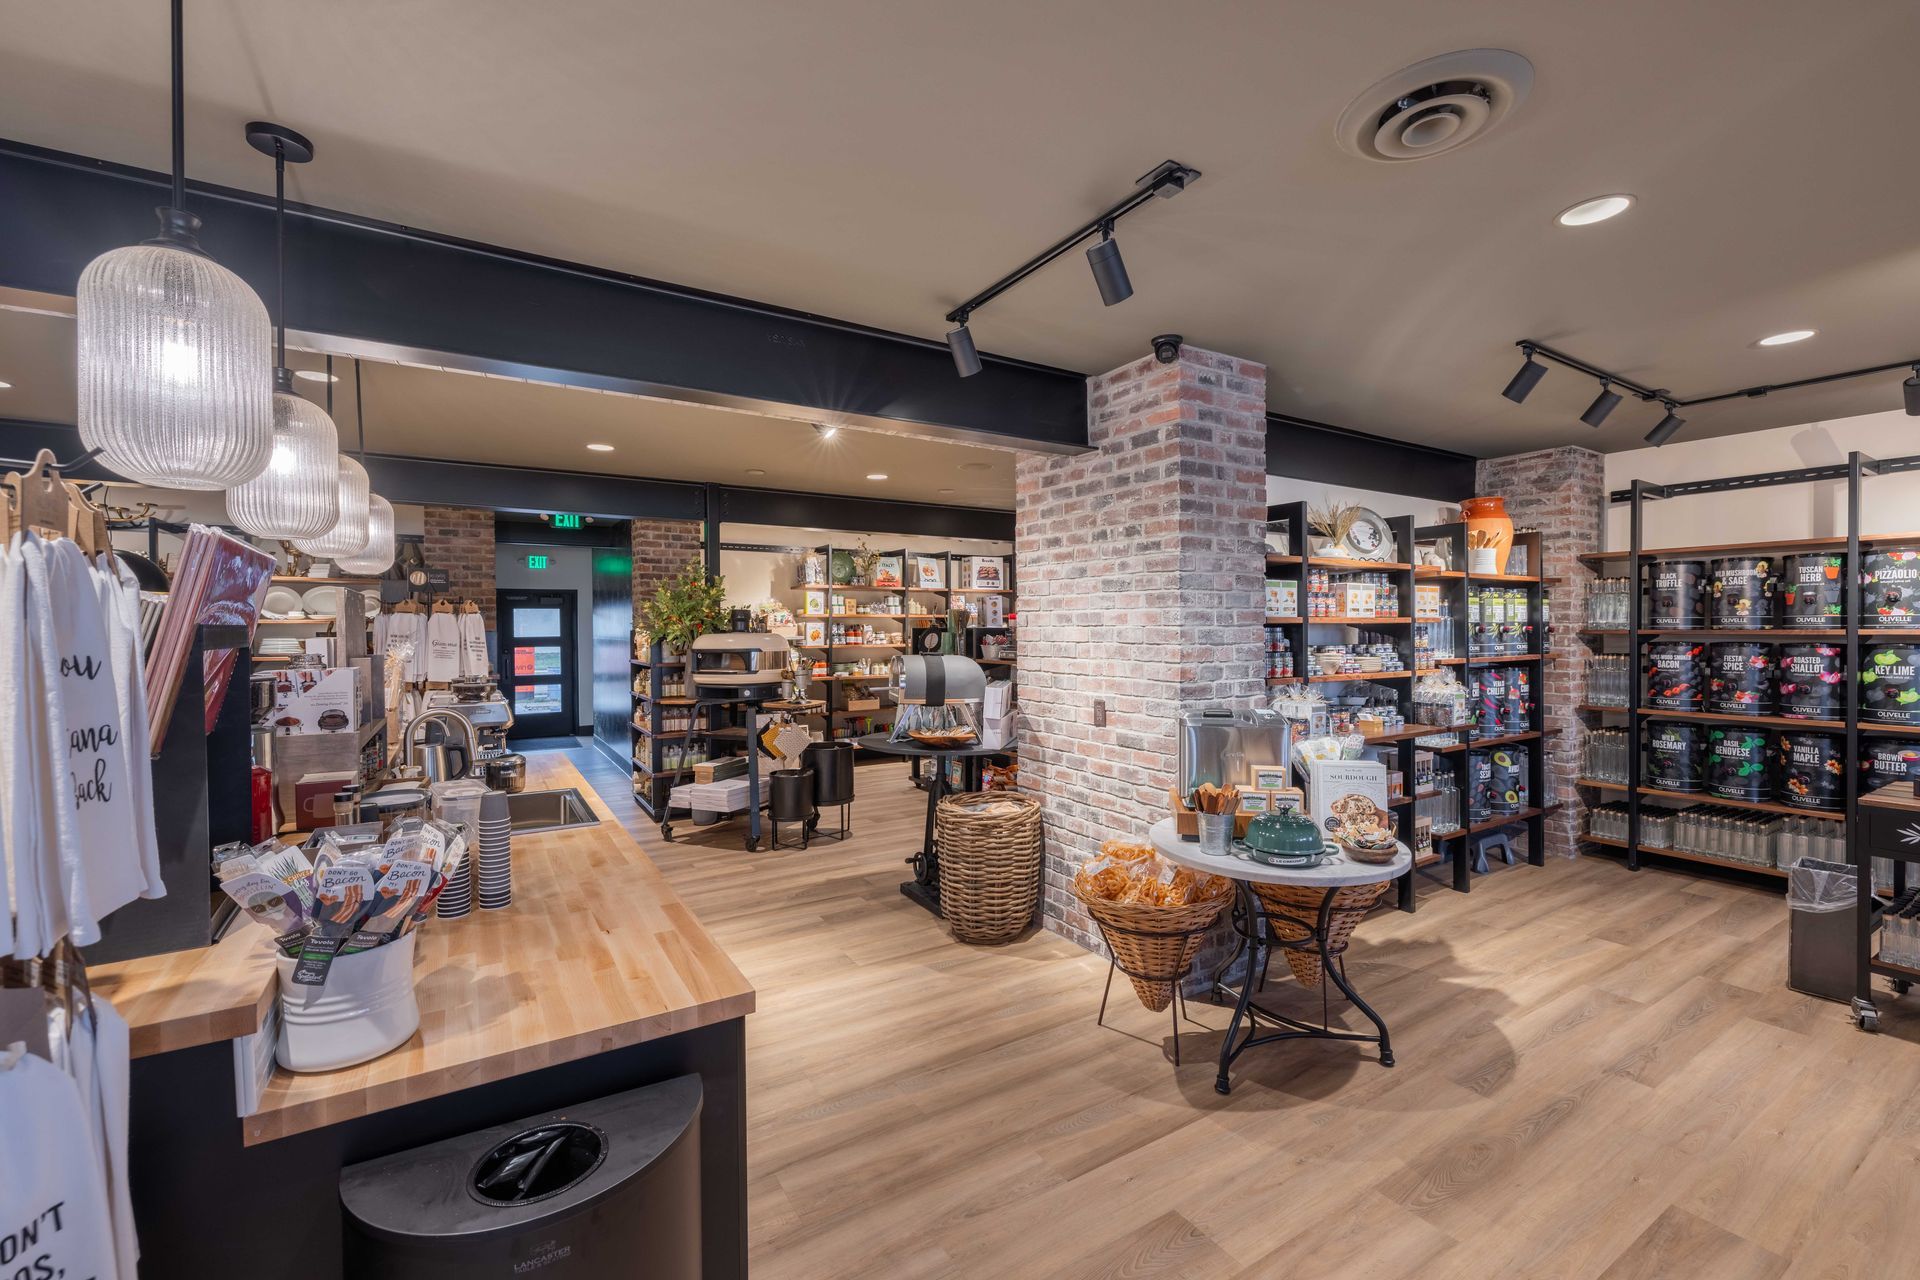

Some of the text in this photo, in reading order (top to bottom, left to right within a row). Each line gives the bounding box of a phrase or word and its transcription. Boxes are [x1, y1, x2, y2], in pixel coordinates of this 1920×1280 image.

[528, 555, 547, 569] EXIT
[1798, 566, 1823, 574] TUSCAN
[1874, 568, 1918, 580] PIZZAOLIO
[1660, 572, 1677, 580] BLACK
[1721, 576, 1748, 586] & SAGE
[1800, 573, 1822, 583] HERB
[1655, 579, 1682, 588] TRUFFLE
[1657, 660, 1680, 669] BACON
[1793, 656, 1821, 664] ROASTED
[60, 654, 102, 680] ou
[1723, 662, 1744, 671] SPICE
[1790, 664, 1824, 674] SHALLOT
[1875, 665, 1915, 676] KEY LIME
[1877, 711, 1911, 719] OLIVELLE
[1652, 740, 1687, 750] ROSEMARY
[1723, 739, 1740, 748] BASIL
[1715, 745, 1750, 757] GENOVESE
[1793, 745, 1819, 754] VANILLA
[1793, 753, 1820, 764] MAPLE
[1877, 752, 1903, 762] BROWN
[1874, 761, 1907, 772] BUTTER
[1656, 779, 1680, 787] OLIVELLE
[1718, 787, 1745, 795] OLIVELLE
[1791, 795, 1821, 804] OLIVELLE
[387, 870, 427, 881] Bacon
[322, 875, 367, 888] Bacon
[0, 1200, 65, 1266] ON'T
